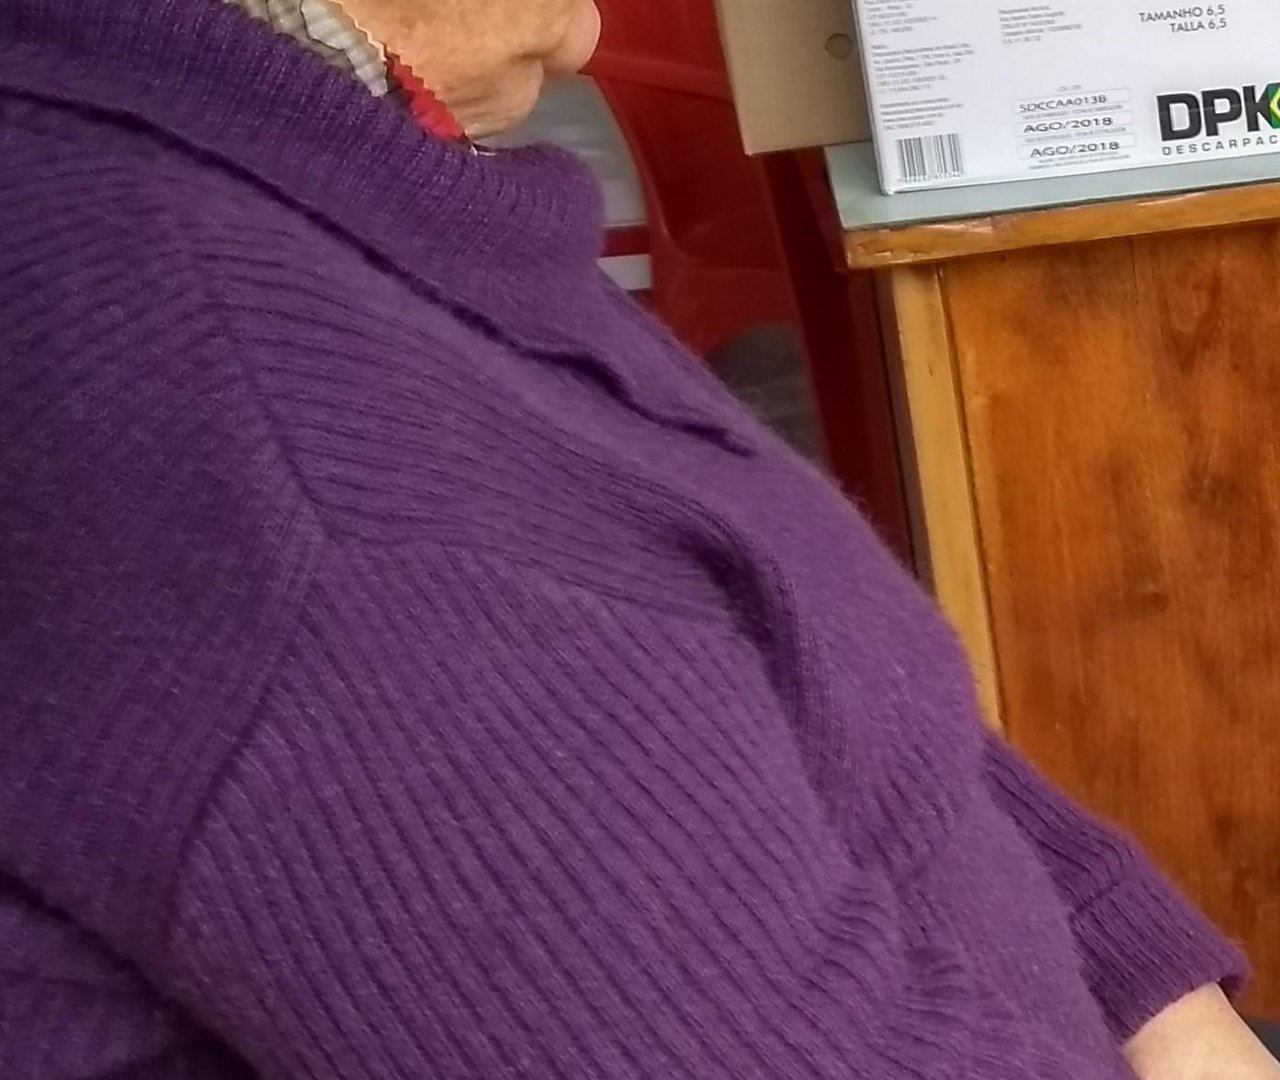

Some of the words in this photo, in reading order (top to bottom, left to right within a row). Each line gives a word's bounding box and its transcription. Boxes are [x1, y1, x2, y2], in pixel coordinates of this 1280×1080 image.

[1138, 6, 1203, 22] TAMANHO
[1206, 4, 1225, 17] 6,5
[1169, 20, 1205, 33] TALLA
[1208, 18, 1227, 30] 6,5
[1023, 117, 1112, 133] AGO/2018
[1030, 141, 1120, 158] AGO/2018
